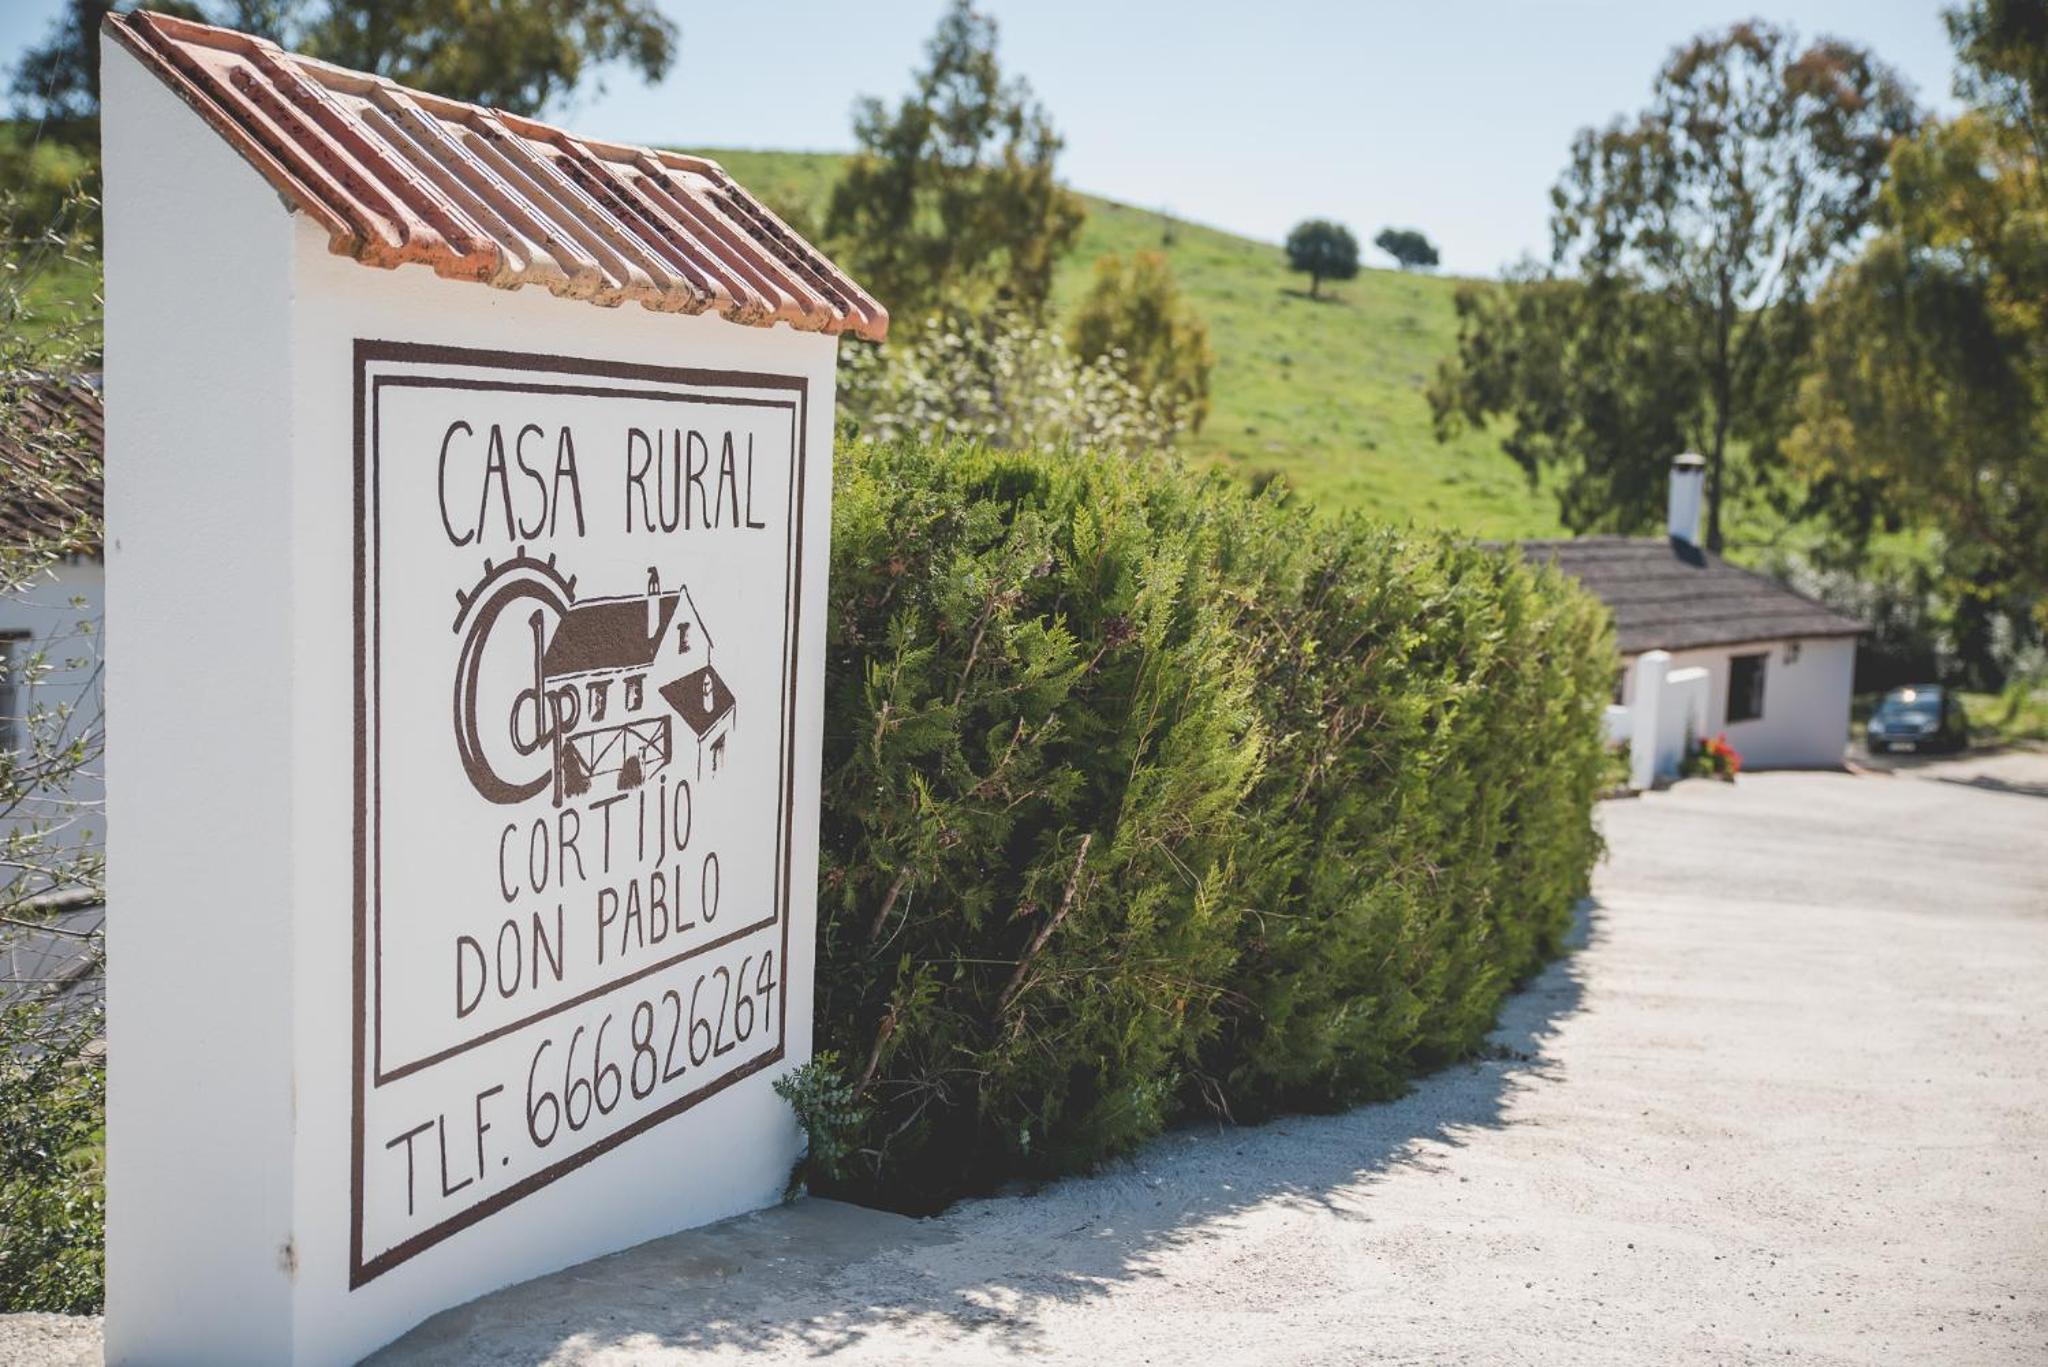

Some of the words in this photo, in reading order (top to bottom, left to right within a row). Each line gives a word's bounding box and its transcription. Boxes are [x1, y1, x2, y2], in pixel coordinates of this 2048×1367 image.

[438, 420, 586, 548] CASA
[626, 428, 766, 534] RURAL
[456, 903, 564, 1019] DON
[597, 851, 720, 965] PABLO
[385, 1083, 510, 1217] TLF.
[526, 949, 777, 1149] 666826264
